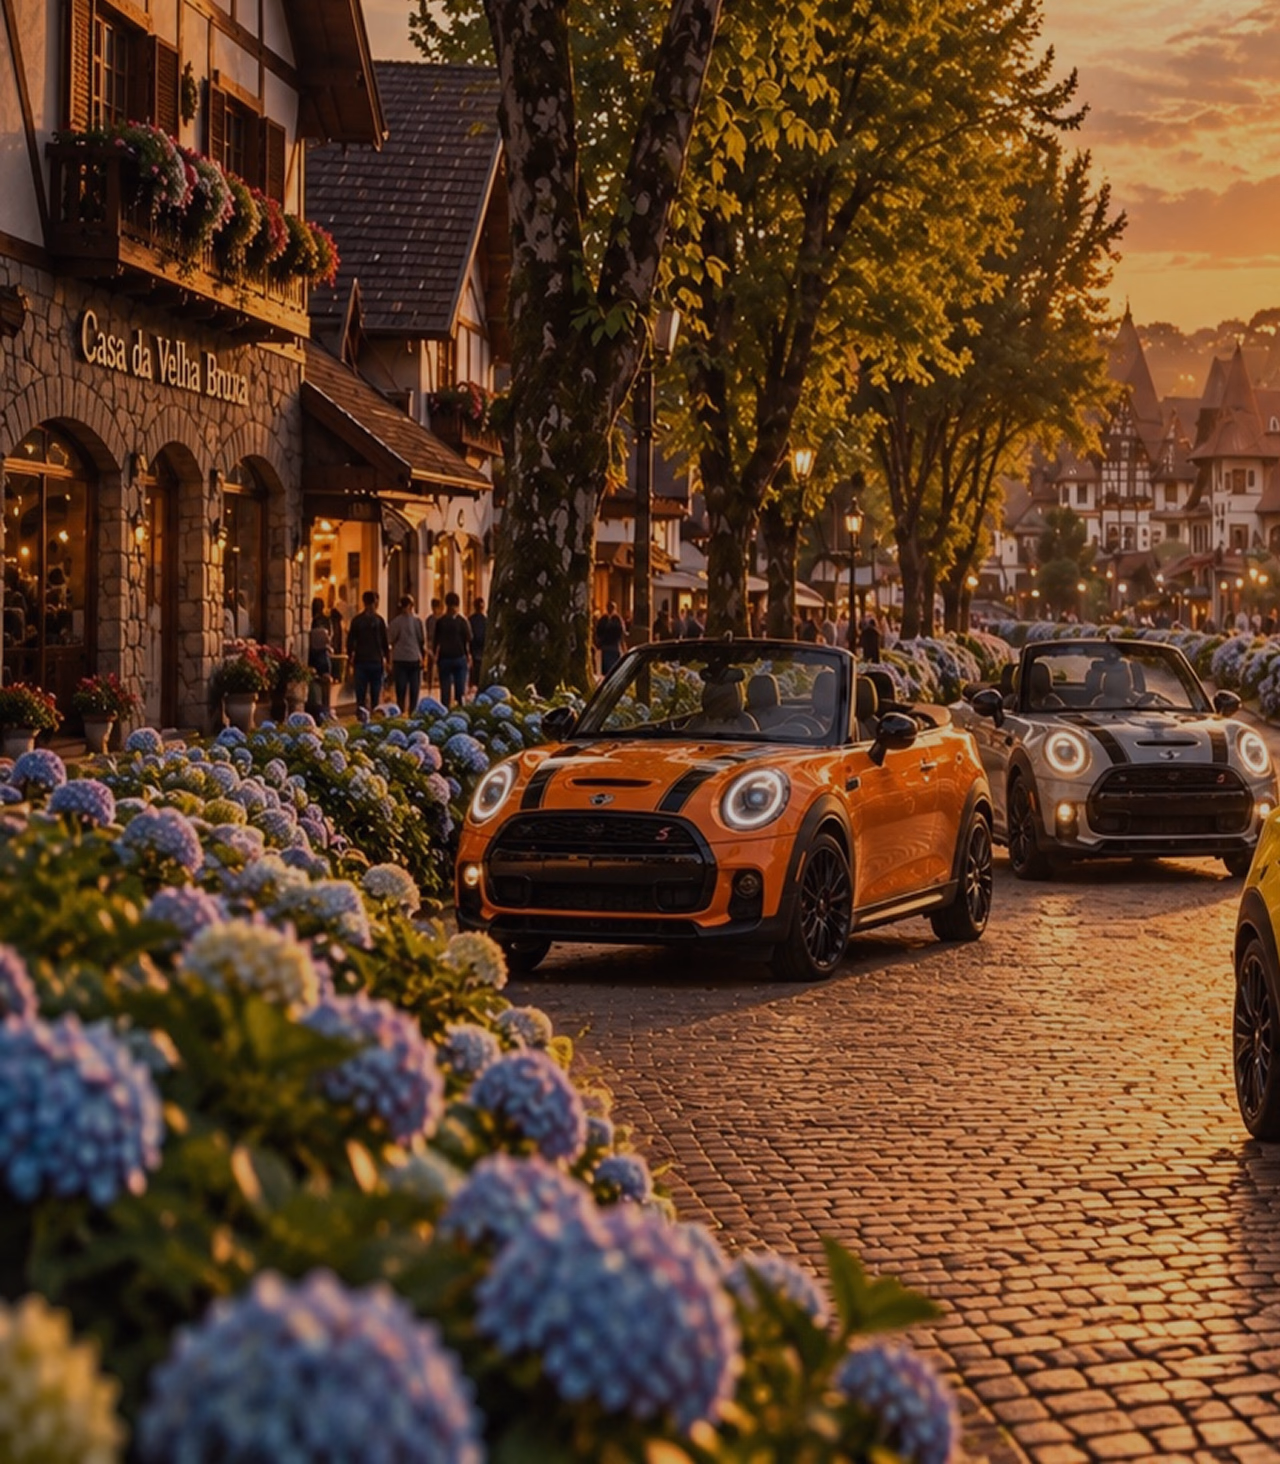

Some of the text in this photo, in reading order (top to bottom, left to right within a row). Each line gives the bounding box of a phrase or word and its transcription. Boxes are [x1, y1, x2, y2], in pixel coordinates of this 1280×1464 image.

[82, 309, 127, 372] Casa
[132, 329, 152, 380] da
[156, 336, 201, 393] Velha
[655, 826, 673, 841] S
